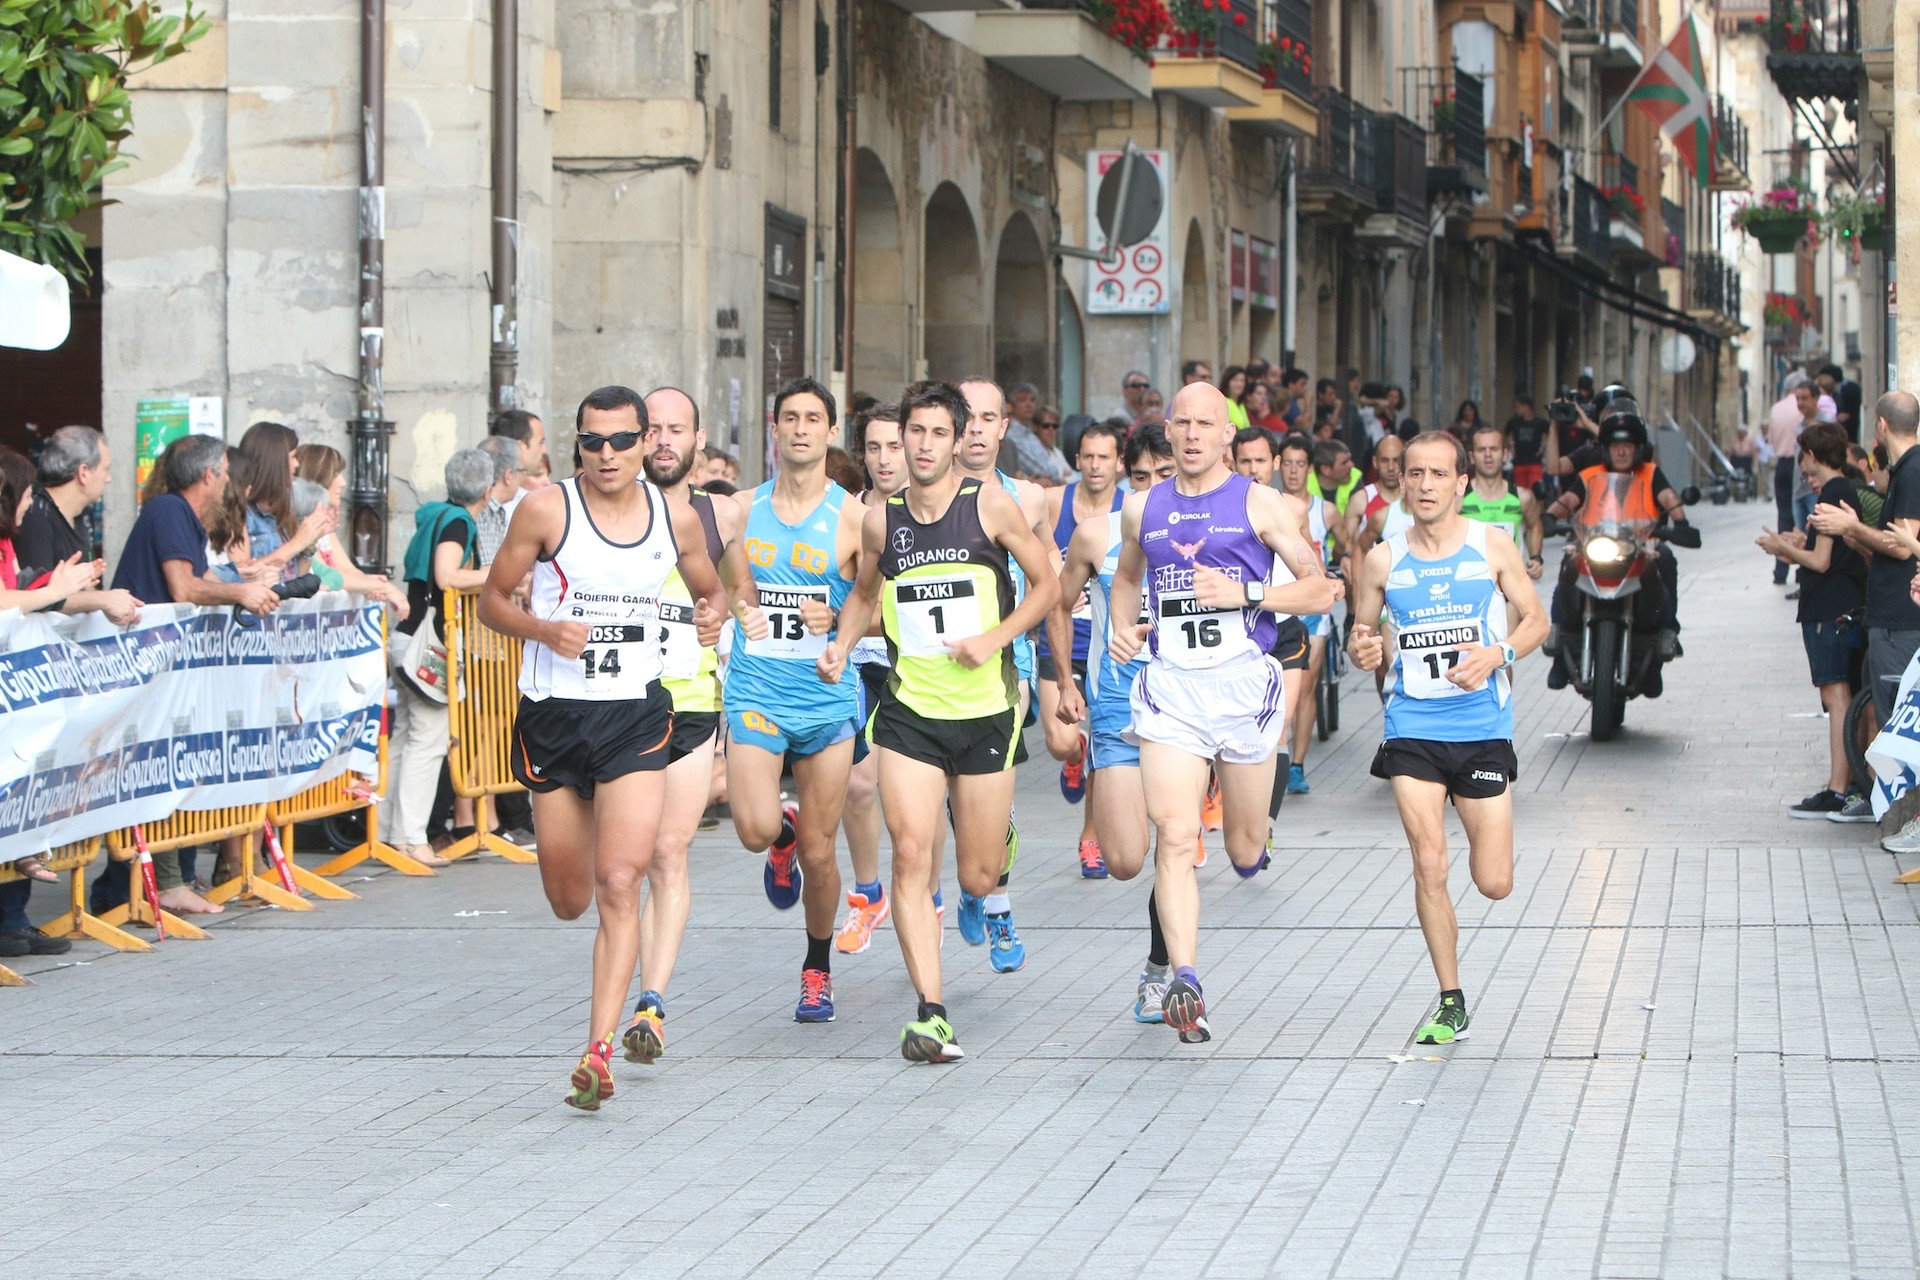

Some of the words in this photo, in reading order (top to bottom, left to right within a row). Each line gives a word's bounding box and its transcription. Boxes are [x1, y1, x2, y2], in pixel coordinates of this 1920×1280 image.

[1181, 512, 1211, 520] KIROLAK
[745, 537, 777, 567] DG
[790, 542, 829, 574] DG
[898, 548, 970, 571] DURANGO
[574, 592, 619, 602] GOIERRI
[913, 583, 954, 599] TXIKI
[928, 606, 945, 634] 1
[1408, 601, 1473, 619] ranking
[769, 613, 804, 640] 13
[1181, 619, 1221, 648] 16
[1405, 628, 1473, 648] ANTONIO
[580, 649, 621, 679] 14
[1423, 651, 1459, 679] 17
[120, 747, 168, 799] Gipuzkoa
